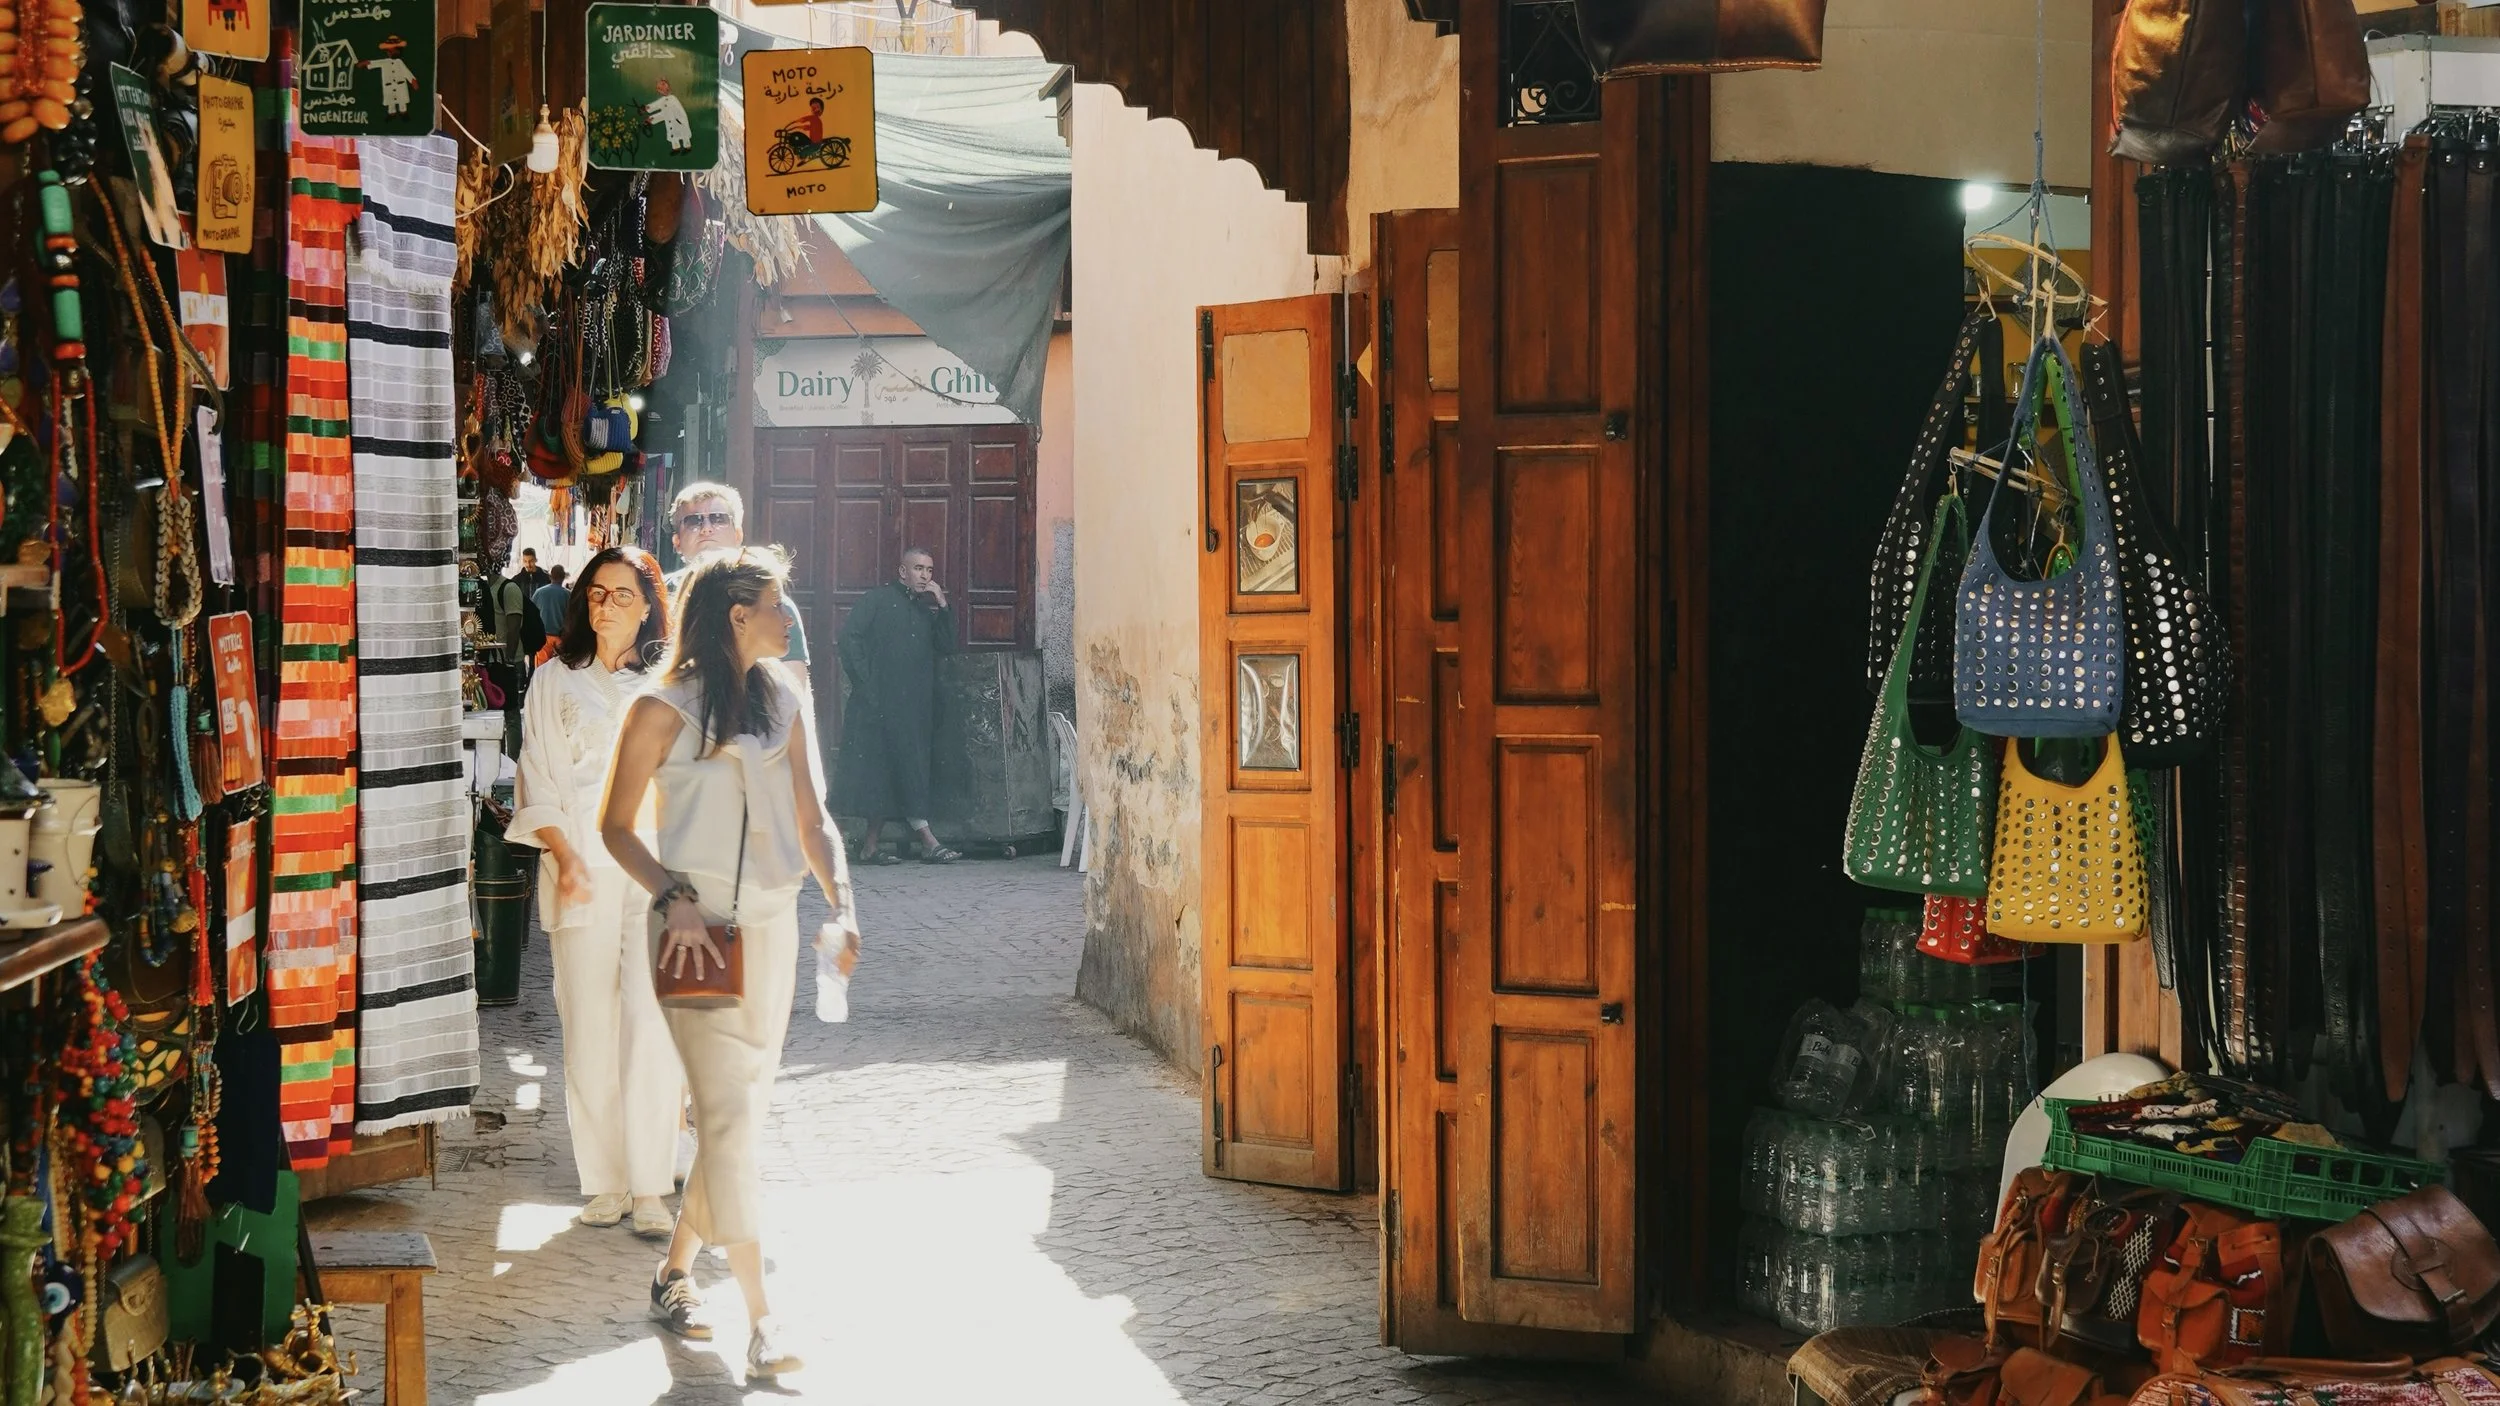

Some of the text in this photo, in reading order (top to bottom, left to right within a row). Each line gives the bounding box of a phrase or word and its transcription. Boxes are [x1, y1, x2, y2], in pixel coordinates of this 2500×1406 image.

[323, 4, 392, 28] مهندس
[602, 22, 696, 44] JARDINIER
[772, 66, 818, 84] MOTO
[303, 93, 356, 111] مهندس
[763, 81, 844, 105] دراجة نارية
[302, 110, 369, 125] INGENIEUR
[786, 183, 827, 199] MOTO
[777, 370, 855, 404] Dairy
